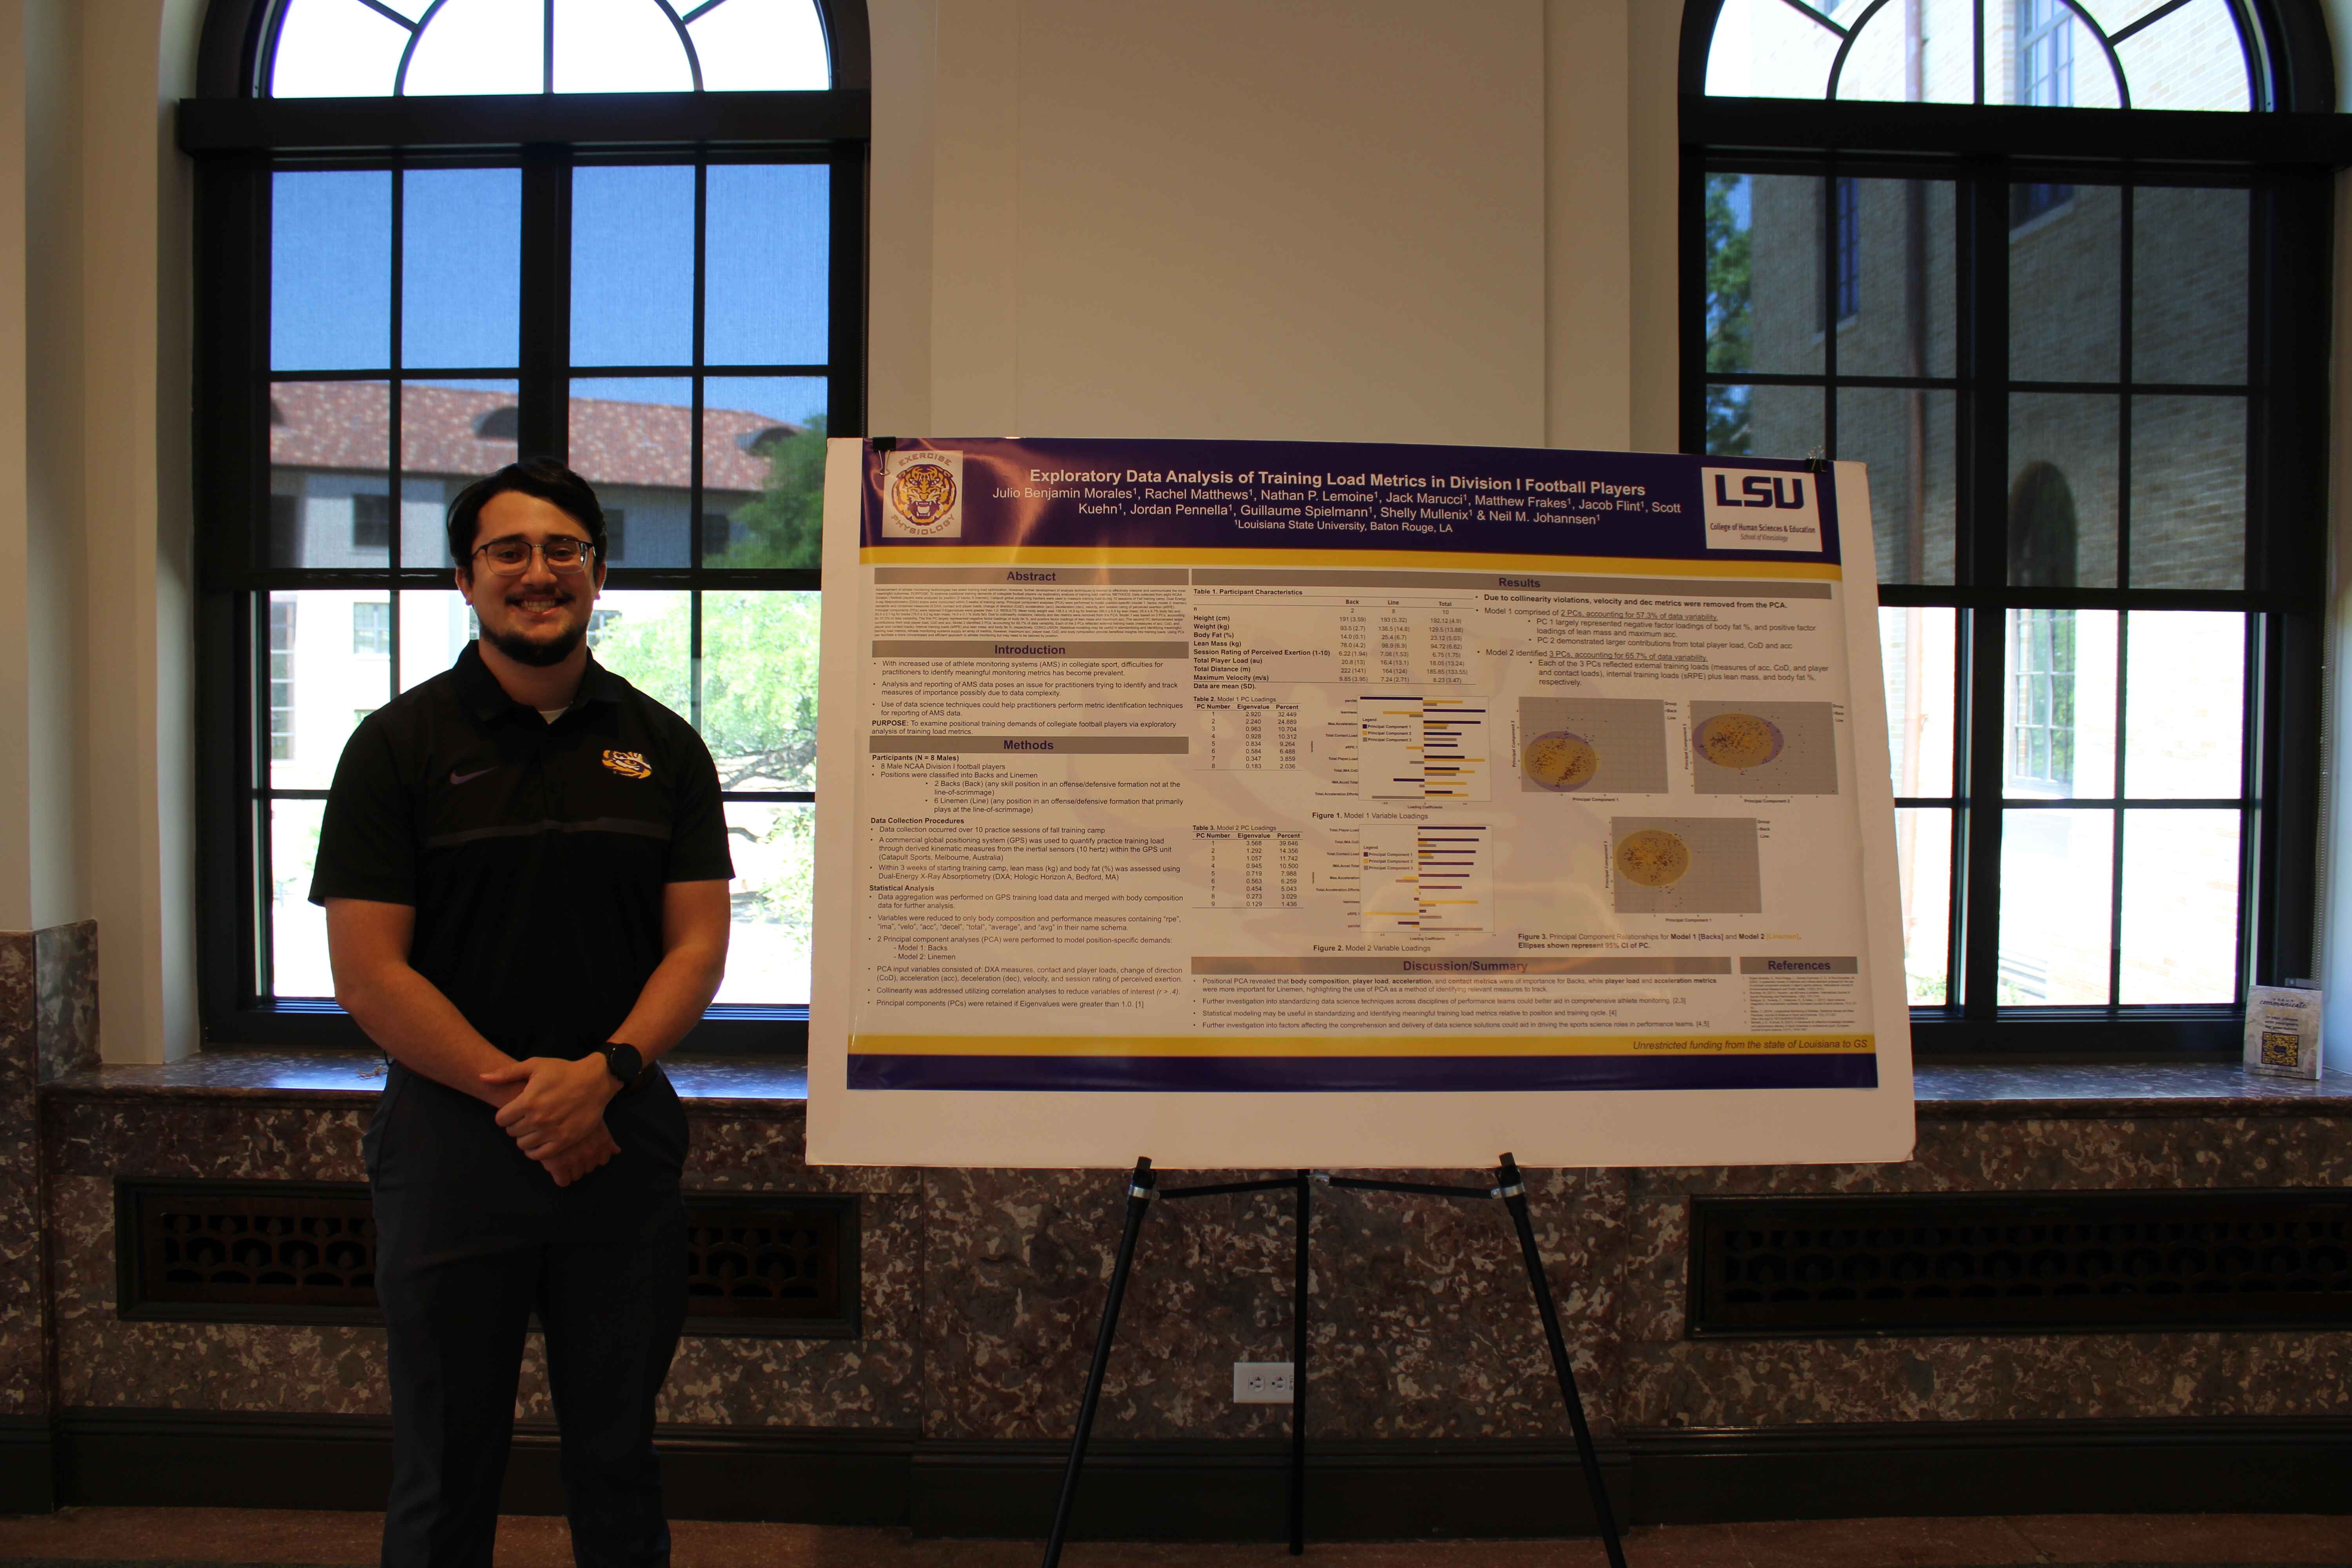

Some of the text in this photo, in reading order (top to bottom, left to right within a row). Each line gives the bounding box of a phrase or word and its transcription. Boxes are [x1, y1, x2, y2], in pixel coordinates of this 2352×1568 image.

[898, 453, 952, 466] EXERCISE
[1030, 469, 1645, 497] Exploratory Data Analysis of Training Load Metrics in Division I Football Players
[1715, 474, 1804, 510] LSU
[993, 487, 1020, 498] Julio
[1025, 487, 1080, 501] Benjamin
[1145, 488, 1187, 499] Rachel
[1261, 490, 1304, 501] Nathan
[1308, 490, 1318, 501] P.
[1386, 492, 1414, 503] Jack
[1475, 495, 1524, 506] Matthew
[1579, 499, 1613, 510] Jacob
[1652, 502, 1681, 513] Scott
[1130, 504, 1171, 515] Jordan
[1241, 505, 1301, 516] Guillaume
[1381, 507, 1417, 521] Shelly
[1477, 510, 1486, 521] &
[1490, 510, 1512, 521] Neil
[1515, 511, 1529, 522] M.
[891, 514, 955, 535] PHYSIOLOGY
[1289, 520, 1314, 529] State
[1317, 521, 1367, 532] University,
[1370, 522, 1399, 530] Baton
[1402, 522, 1436, 534] Rouge,
[1439, 524, 1453, 532] LA
[1710, 523, 1731, 532] College
[1789, 525, 1816, 534] Education
[1007, 571, 1056, 581] Abstract
[1499, 577, 1541, 588] Results
[1510, 595, 1551, 604] collinearity
[995, 644, 1065, 655] Introduction
[1004, 740, 1054, 750] Methods
[1403, 961, 1528, 973] Discussion/Summary
[1768, 960, 1831, 970] References
[1633, 1041, 1688, 1050] Unrestricted
[1690, 1041, 1723, 1051] funding
[1725, 1040, 1745, 1049] from
[1747, 1040, 1761, 1049] the
[1788, 1040, 1798, 1049] of
[1798, 1040, 1840, 1048] Louisiana
[1853, 1039, 1867, 1048] GS
